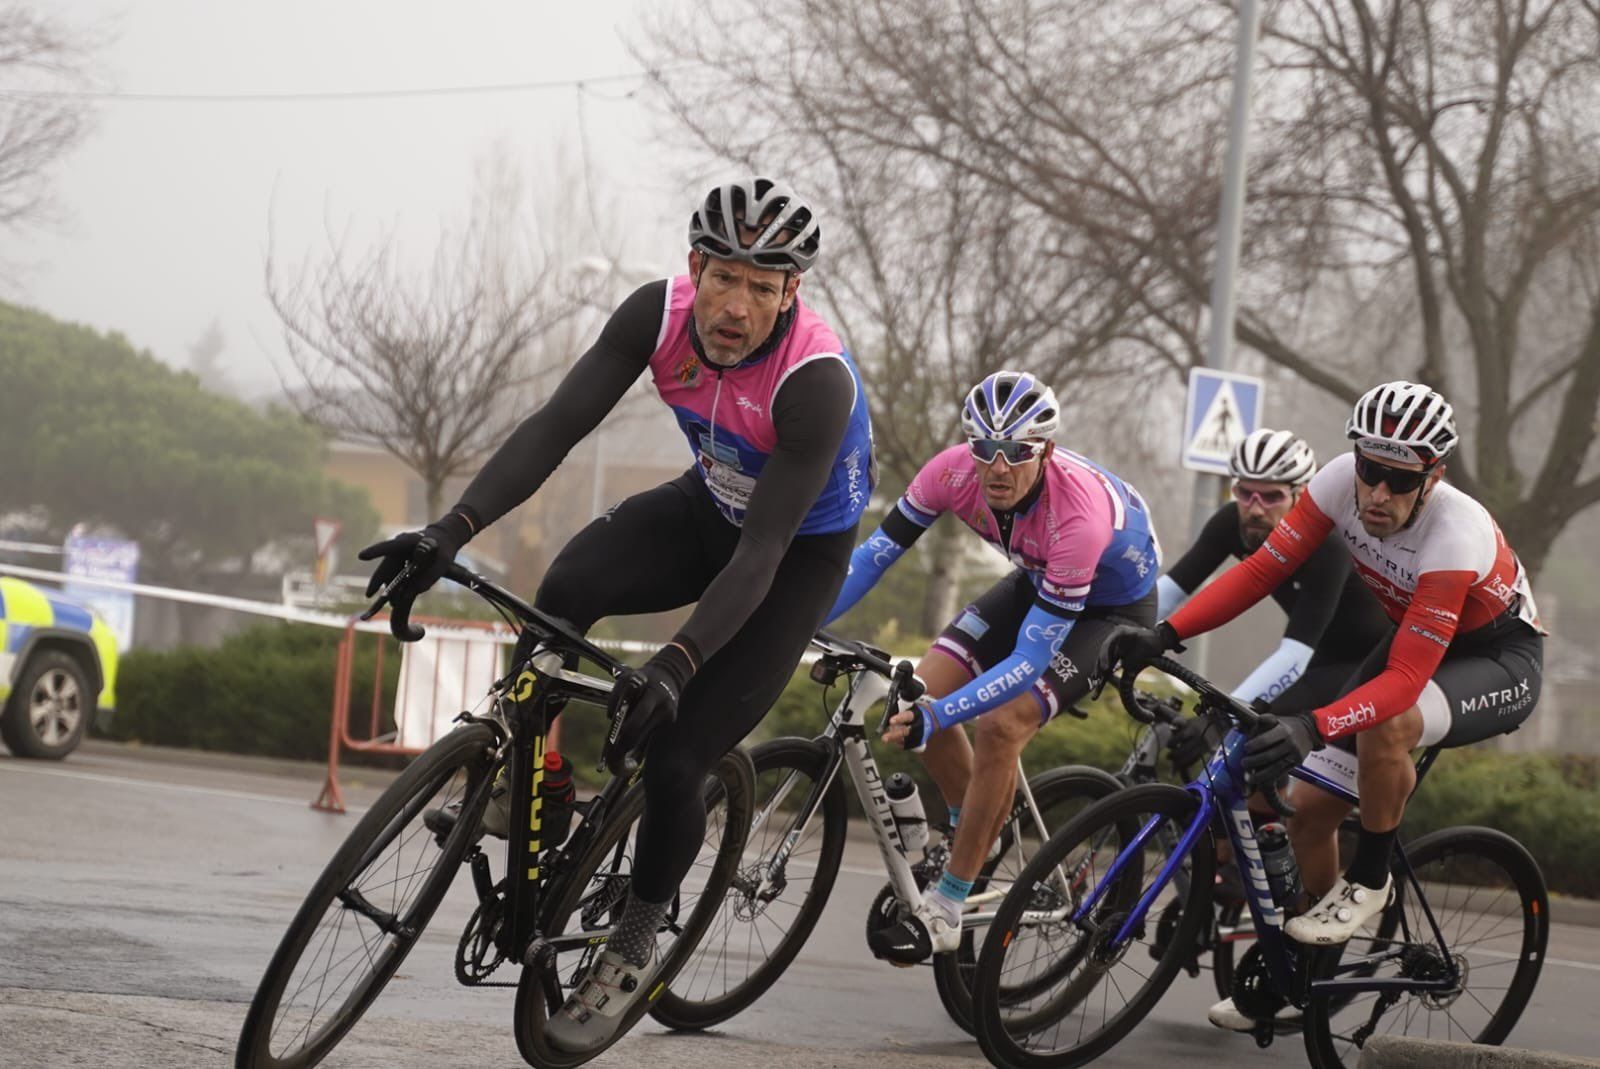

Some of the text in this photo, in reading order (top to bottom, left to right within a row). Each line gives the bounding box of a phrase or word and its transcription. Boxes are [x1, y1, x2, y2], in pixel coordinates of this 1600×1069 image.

[1344, 529, 1415, 583] MATRIX
[944, 661, 1035, 716] C.C. GETAFE
[1461, 678, 1529, 715] MATRIX
[1498, 693, 1532, 717] FITNESS
